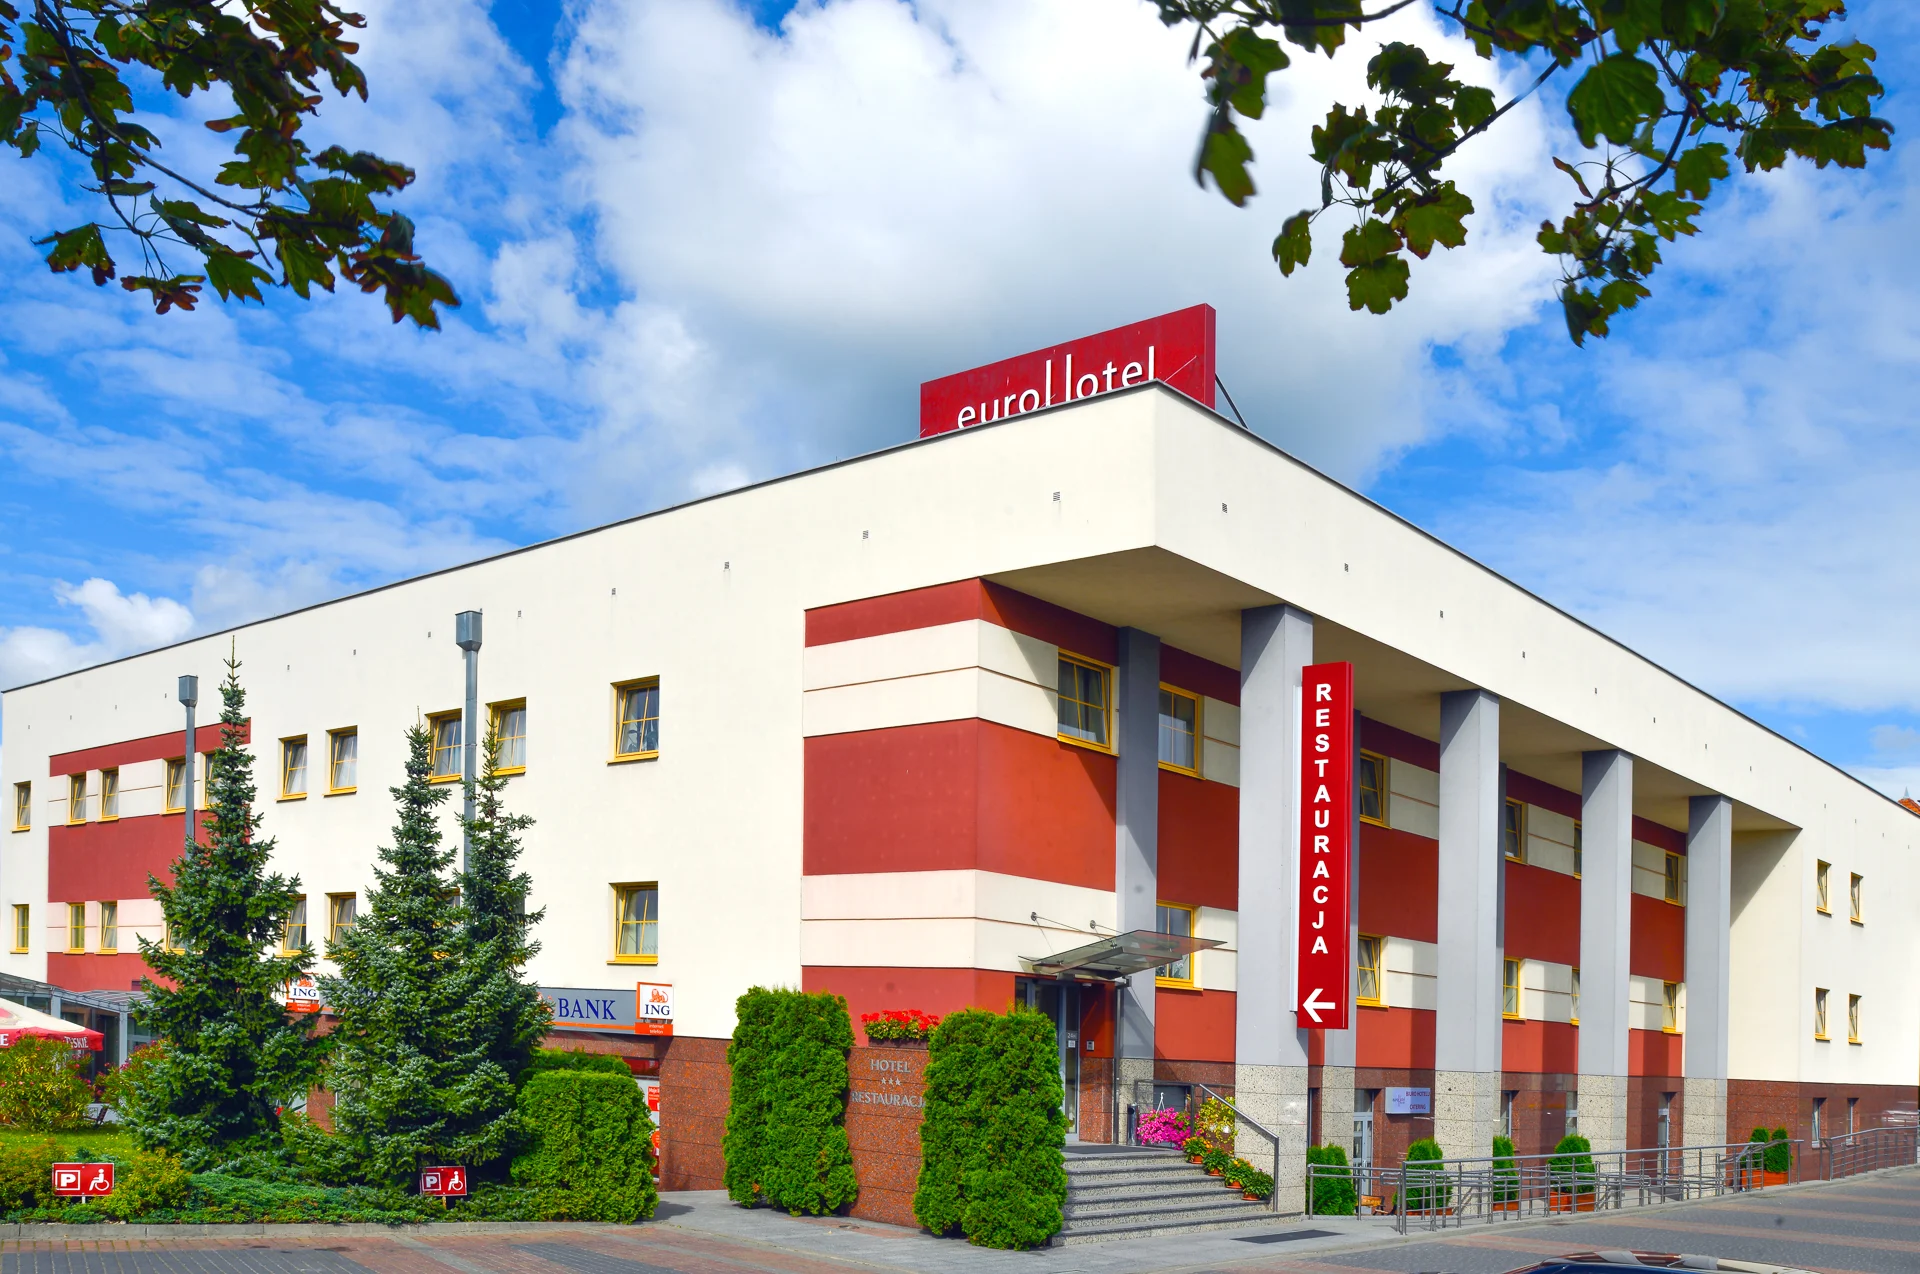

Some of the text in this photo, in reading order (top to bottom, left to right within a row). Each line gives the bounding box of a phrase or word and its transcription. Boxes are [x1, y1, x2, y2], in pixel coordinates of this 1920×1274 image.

[1311, 683, 1333, 955] RESTAURACJA
[293, 988, 317, 998] ING
[558, 998, 617, 1020] BANK
[644, 1004, 671, 1015] ING
[870, 1059, 911, 1073] HOTEL
[851, 1091, 926, 1109] RESTAURACJ
[61, 1174, 76, 1187] P
[426, 1175, 438, 1188] P
